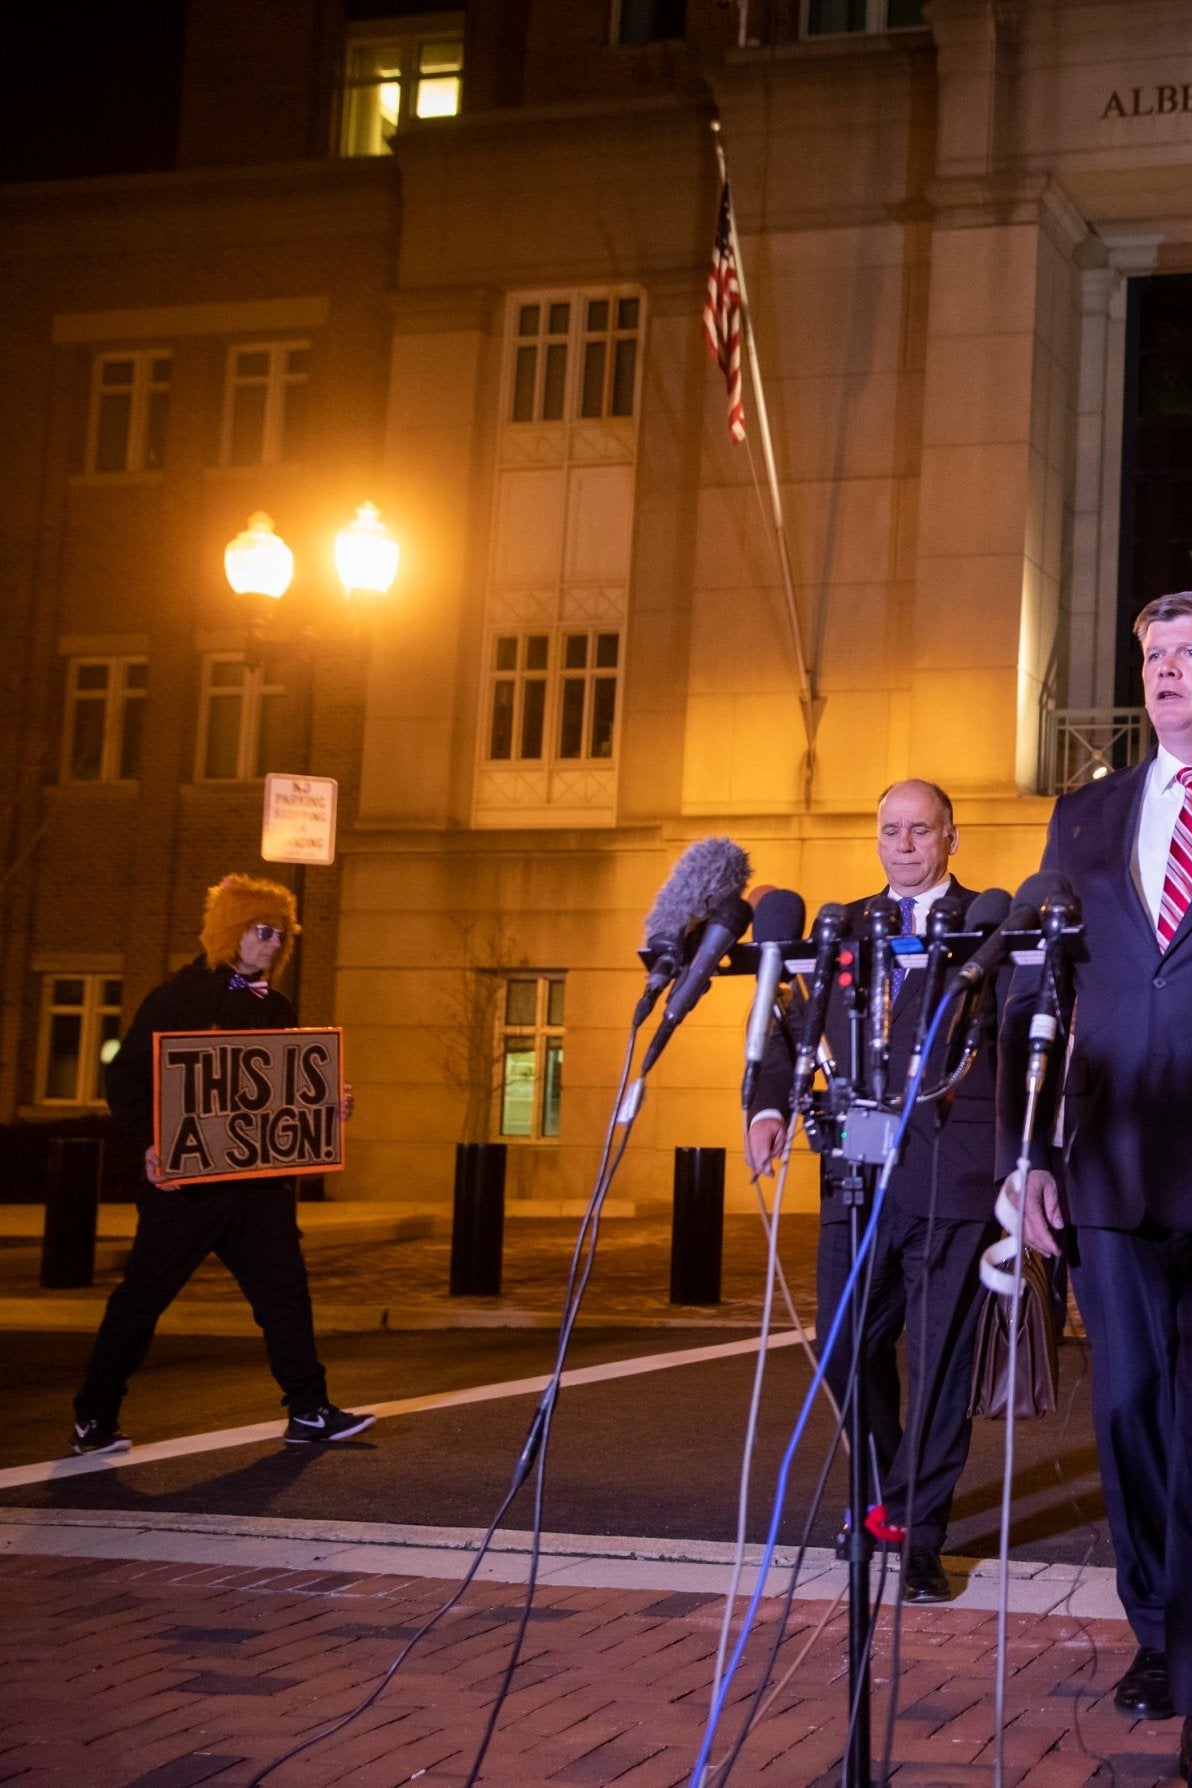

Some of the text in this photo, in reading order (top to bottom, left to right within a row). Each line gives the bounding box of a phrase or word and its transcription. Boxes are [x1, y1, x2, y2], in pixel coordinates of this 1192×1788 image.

[167, 1045, 329, 1116] THIS IS
[166, 1107, 337, 1173] A SIGN!
